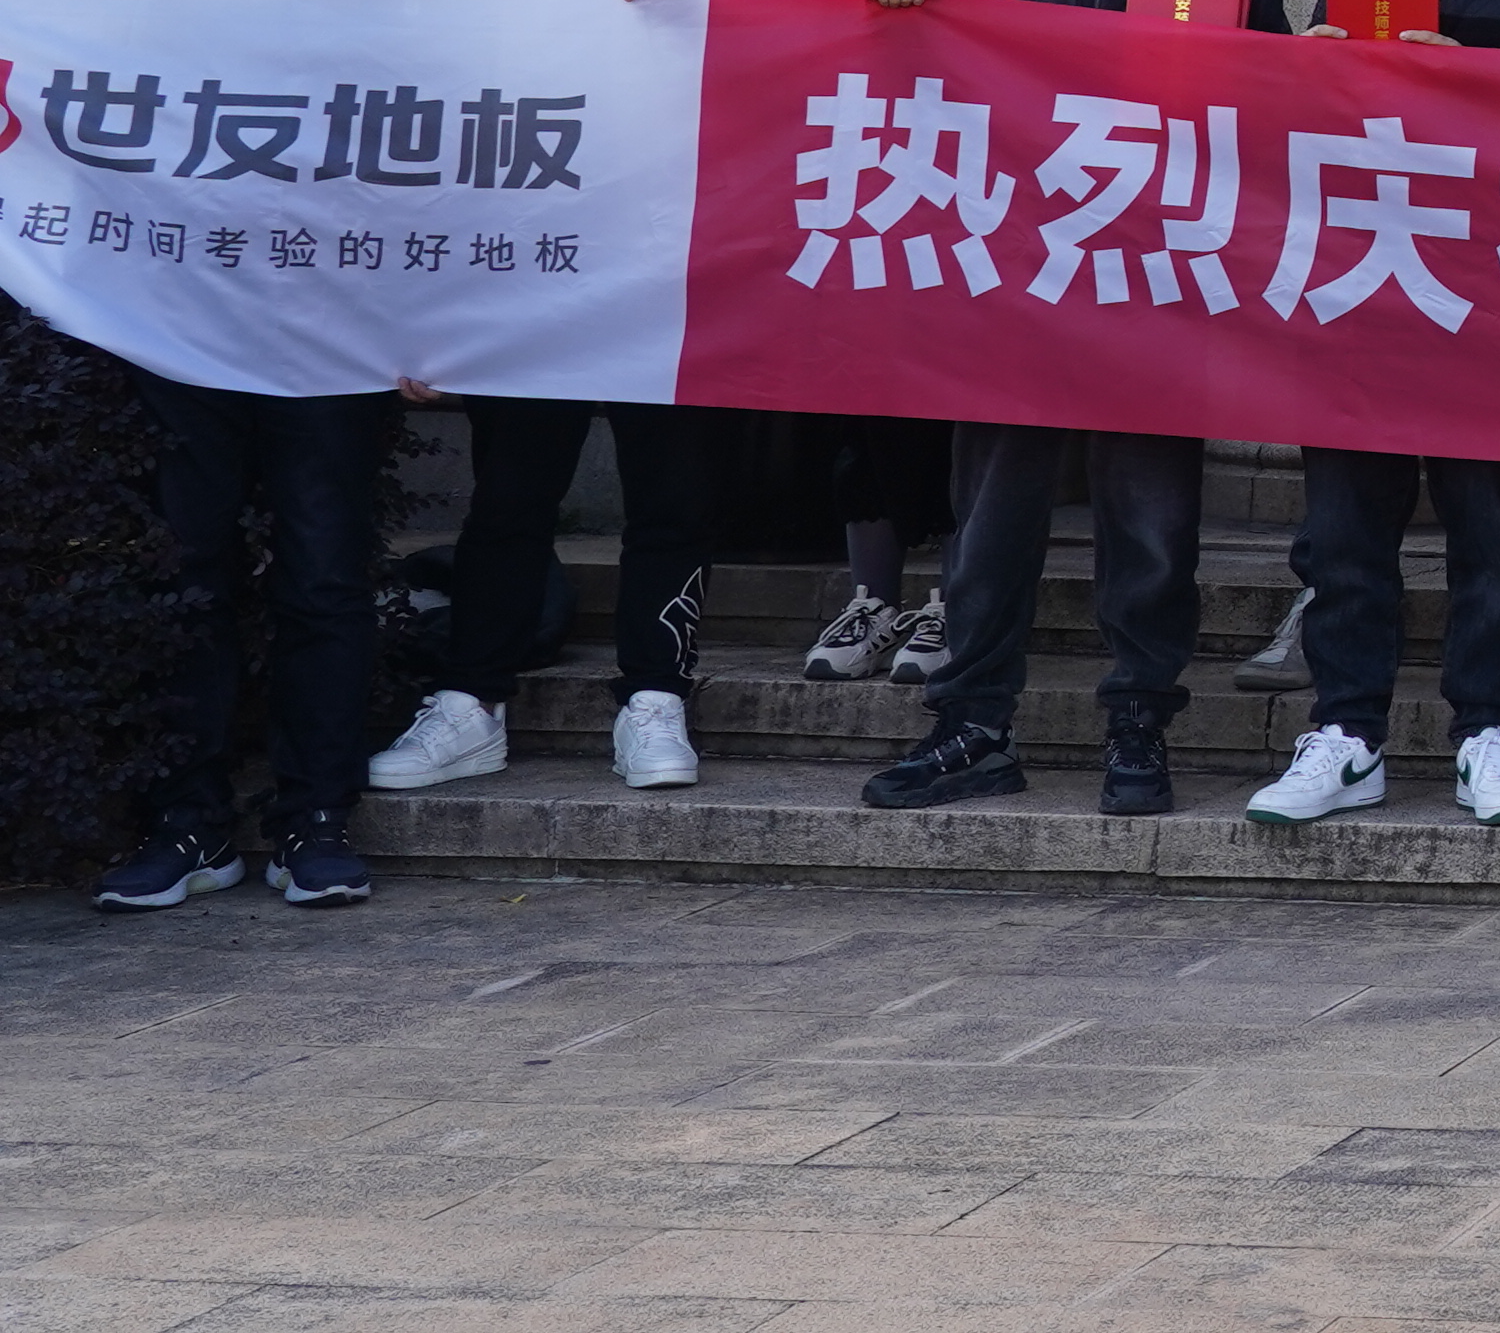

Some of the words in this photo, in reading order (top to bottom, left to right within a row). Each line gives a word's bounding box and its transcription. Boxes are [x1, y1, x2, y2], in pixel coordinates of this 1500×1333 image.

[41, 68, 586, 190] 世友地板
[0, 198, 580, 275] 起时间考验的好地板
